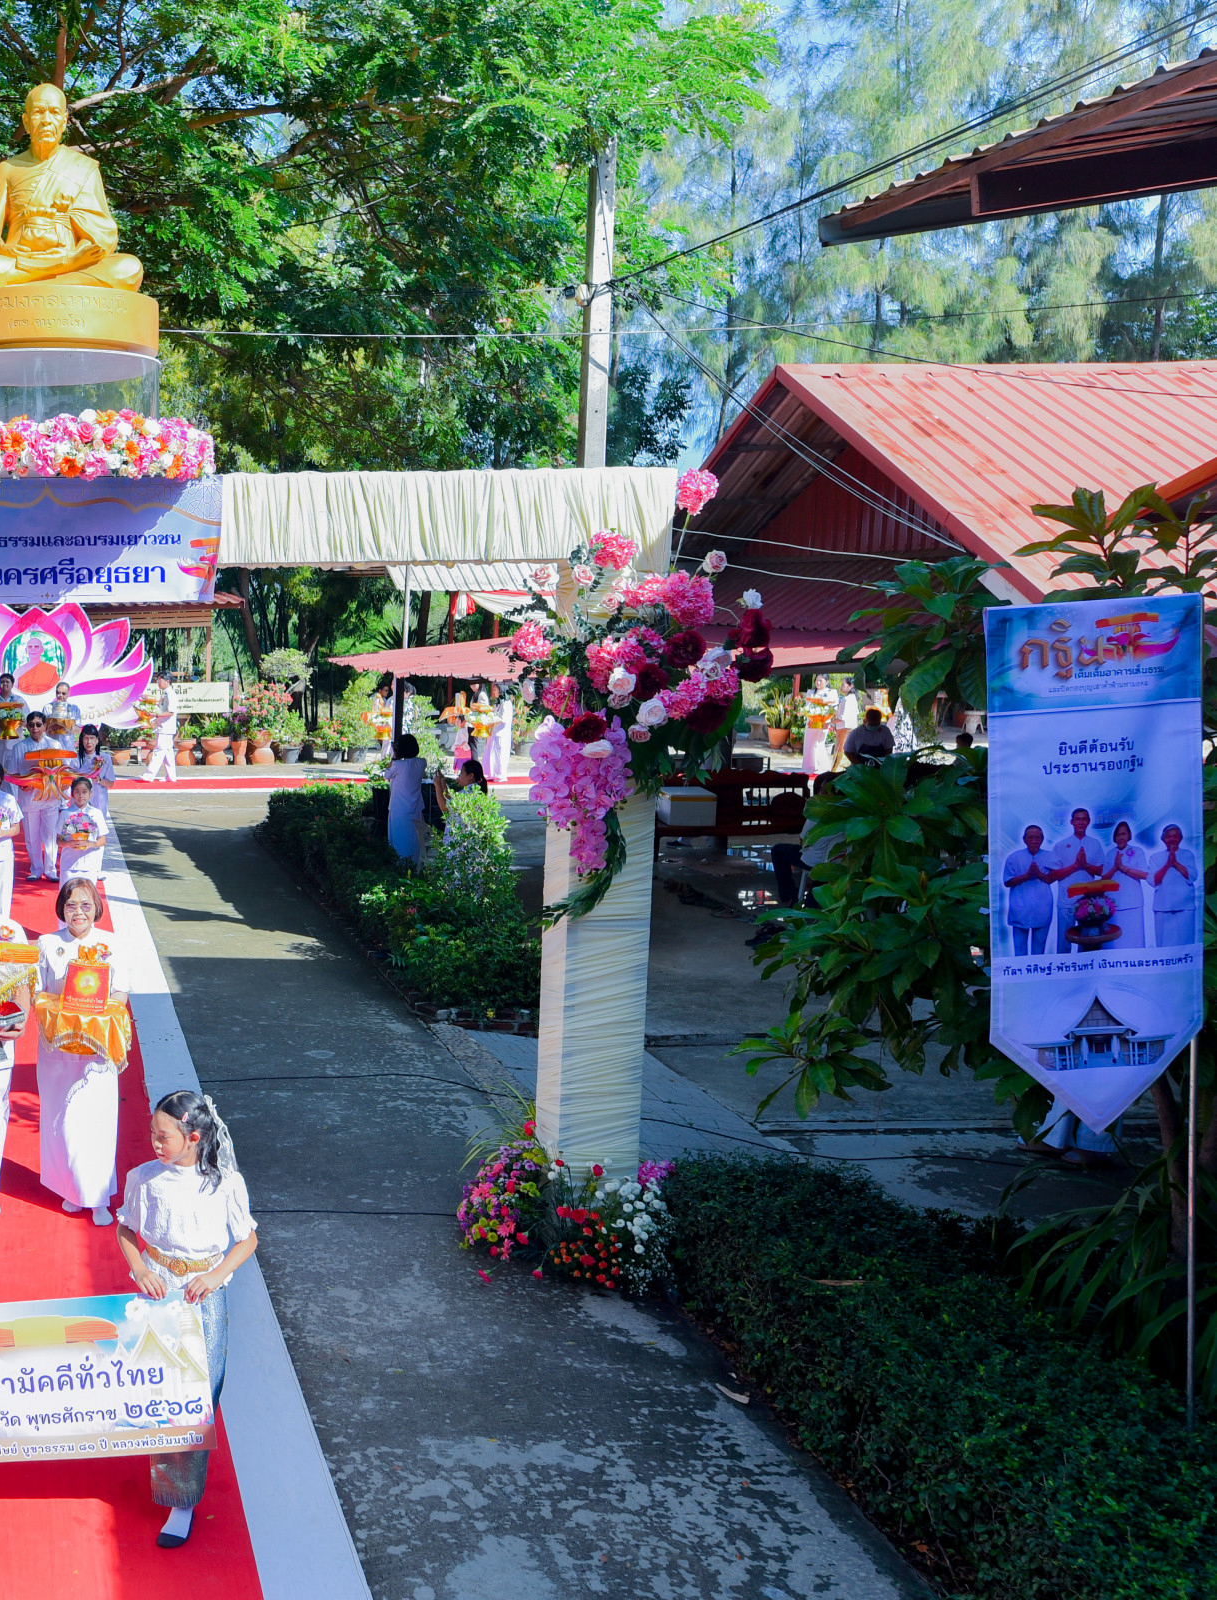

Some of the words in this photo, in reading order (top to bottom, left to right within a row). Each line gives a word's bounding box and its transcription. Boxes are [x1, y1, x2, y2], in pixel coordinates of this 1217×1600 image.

[1058, 736, 1134, 756] ยินดีต้อนรับ
[1043, 755, 1144, 775] ประธานรองกฐิน
[1003, 966, 1023, 976] กัลฯ
[1098, 954, 1194, 969] เงินกรและครอบครัว
[0, 1410, 21, 1427] วัด
[26, 1407, 118, 1431] พุทธศักราช
[124, 1397, 203, 1419] ๒๕๖๘
[21, 1442, 75, 1459] บูชาธรรม
[99, 1437, 108, 1451] ปี
[111, 1432, 204, 1450] หลวงพ่อธัมมชโย
